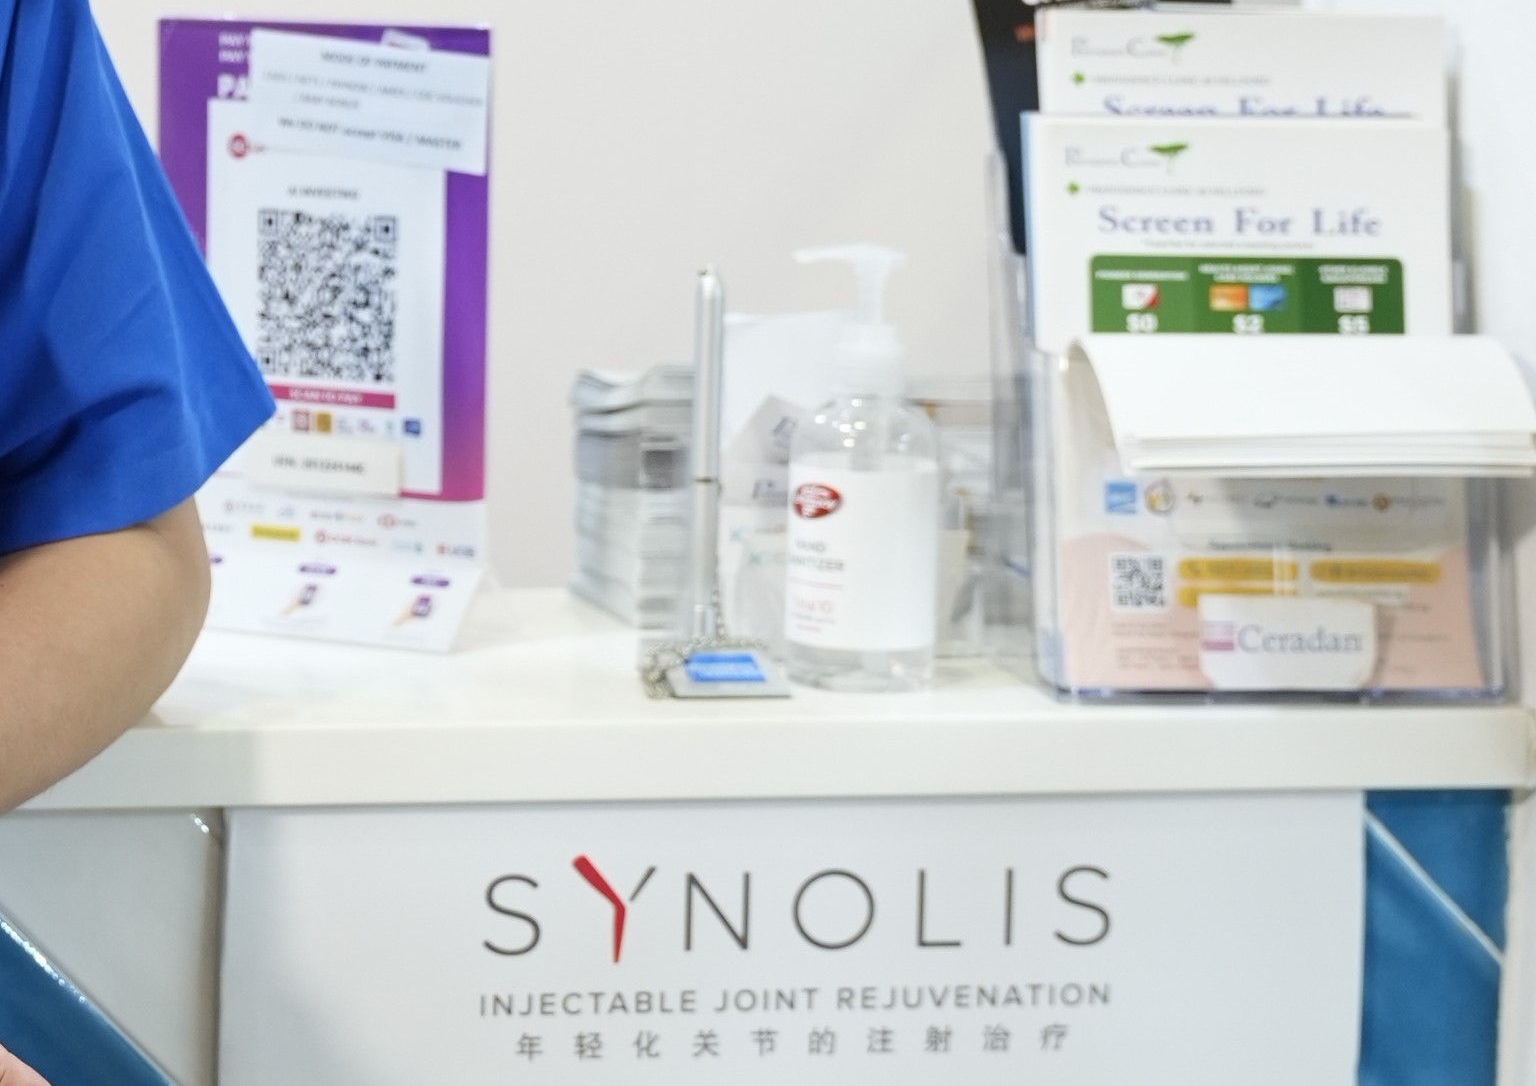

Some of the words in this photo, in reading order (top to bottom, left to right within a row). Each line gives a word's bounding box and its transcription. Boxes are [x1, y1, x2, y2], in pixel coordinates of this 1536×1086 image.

[1097, 203, 1215, 236] Screen
[1234, 206, 1292, 236] For
[1312, 205, 1381, 236] Life
[1237, 623, 1363, 654] Ceradan
[482, 854, 1114, 964] SYNOLIS
[479, 989, 698, 1017] INJECTABLE
[713, 987, 821, 1013] JOINT
[835, 981, 1112, 1010] REJUVENATION
[516, 1022, 1069, 1061] 年轻化关节的注射治疗
